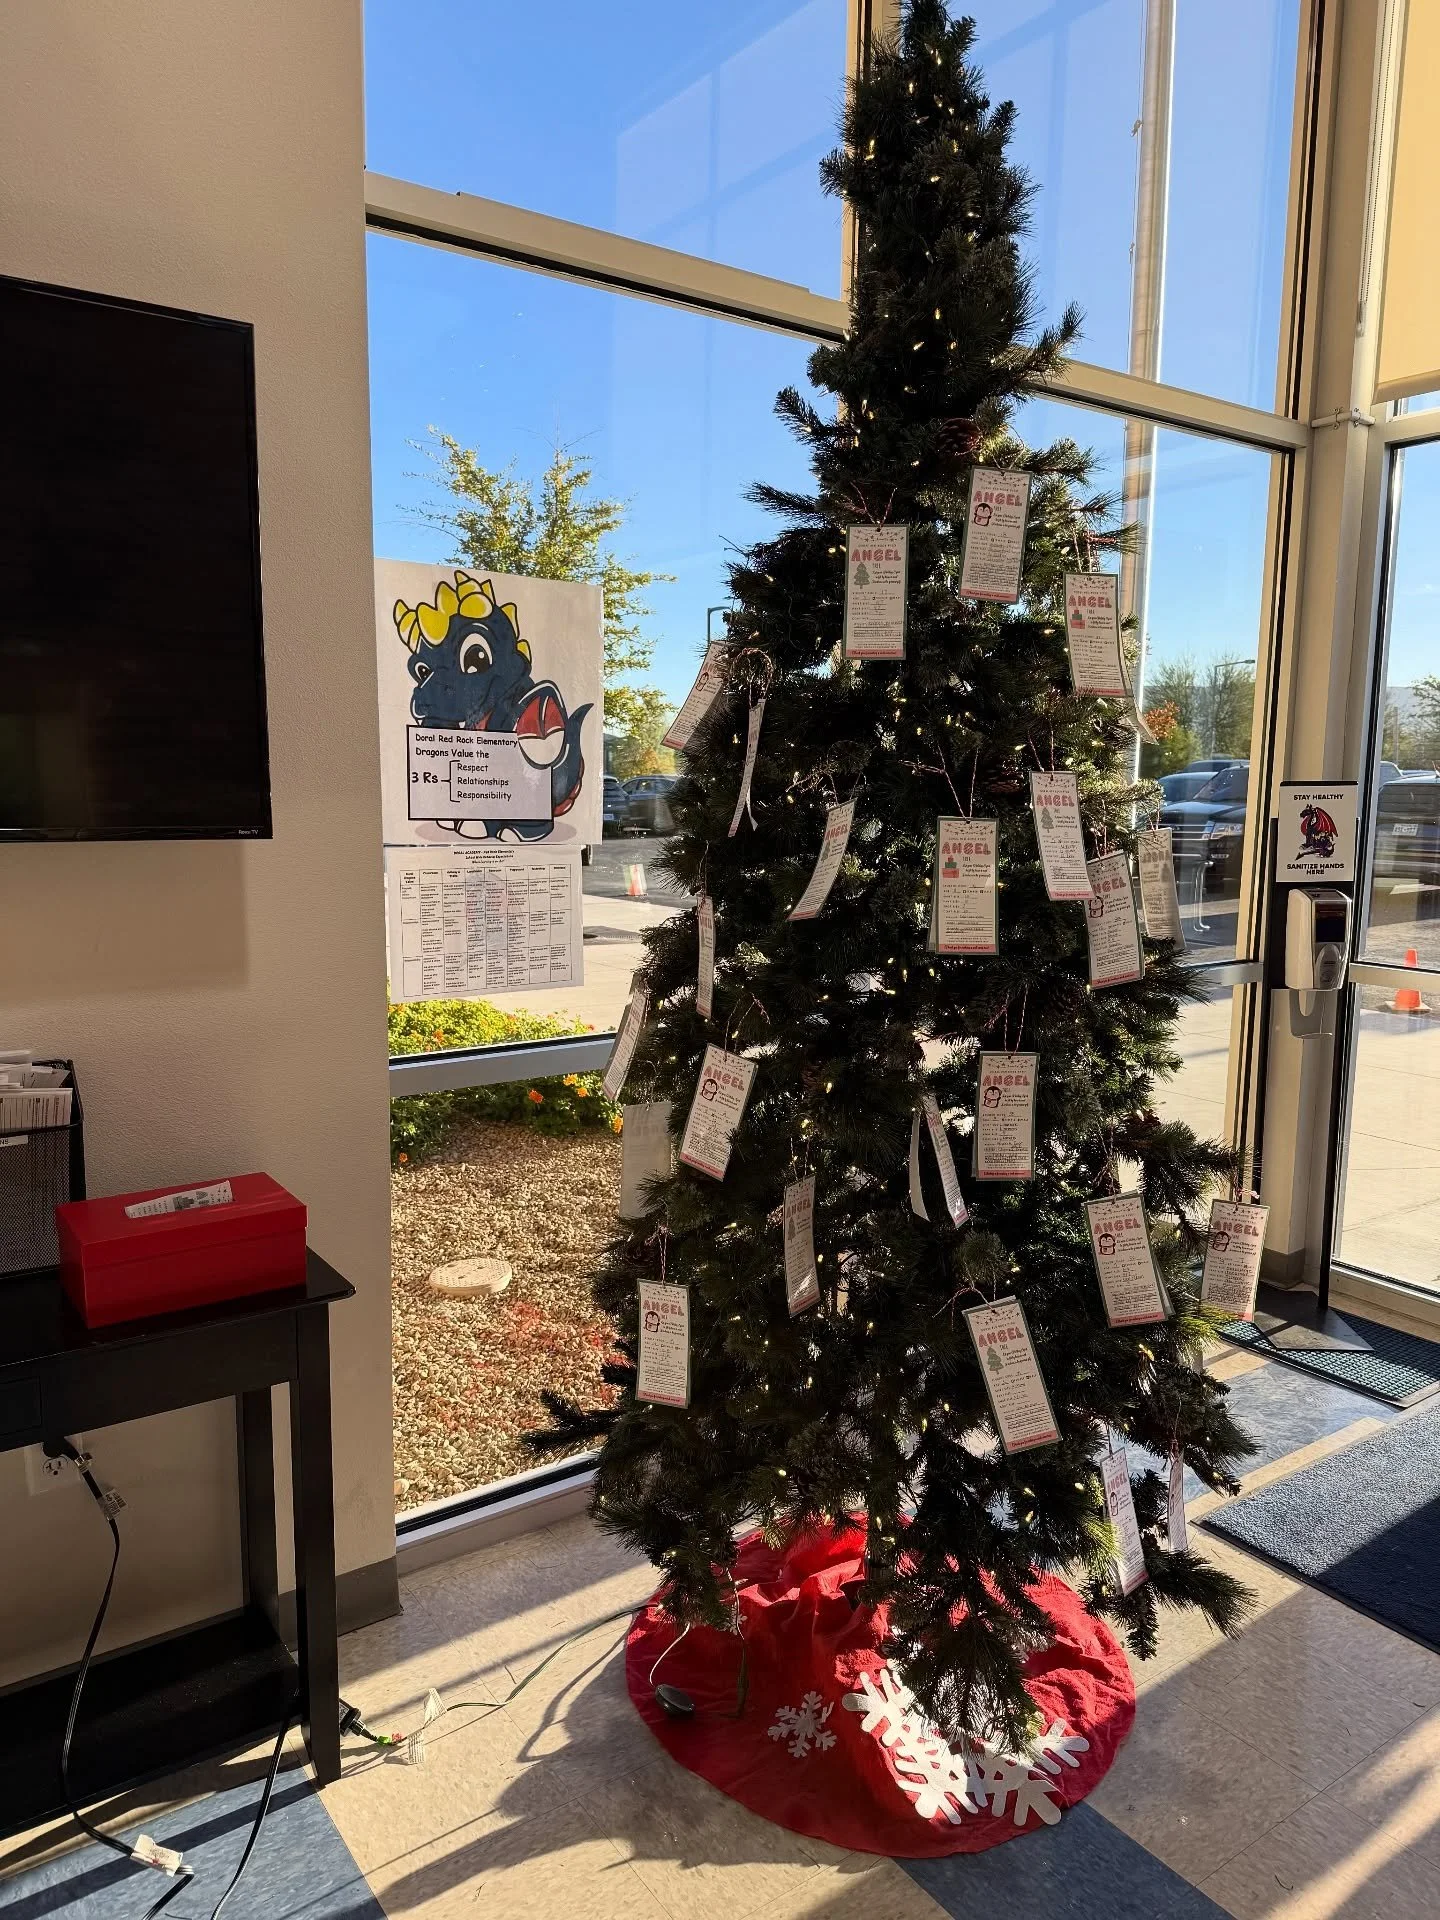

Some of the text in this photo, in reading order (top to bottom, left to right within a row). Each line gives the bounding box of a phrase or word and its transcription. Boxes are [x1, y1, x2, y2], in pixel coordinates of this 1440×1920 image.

[973, 491, 1023, 507] ANGEL
[851, 549, 901, 562] ANGEL
[1068, 595, 1112, 609] ANGEL
[415, 733, 518, 748] Doral Red Rock Elementary
[415, 747, 490, 759] Dragons Value the
[457, 763, 489, 773] Respect
[411, 772, 439, 783] 3 Rs
[457, 777, 509, 788] Relationships
[457, 791, 512, 801] Responsibility
[1036, 794, 1075, 807] ANGEL
[824, 824, 849, 841] ANGEL
[942, 842, 992, 855] ANGEL
[1092, 877, 1127, 895] NGEL
[703, 1065, 745, 1091] ANGEL
[982, 1074, 1031, 1087] ANGEL
[1093, 1217, 1141, 1235] ANGEL
[642, 1300, 685, 1316] ANGEL
[978, 1326, 1025, 1347] ANGEL
